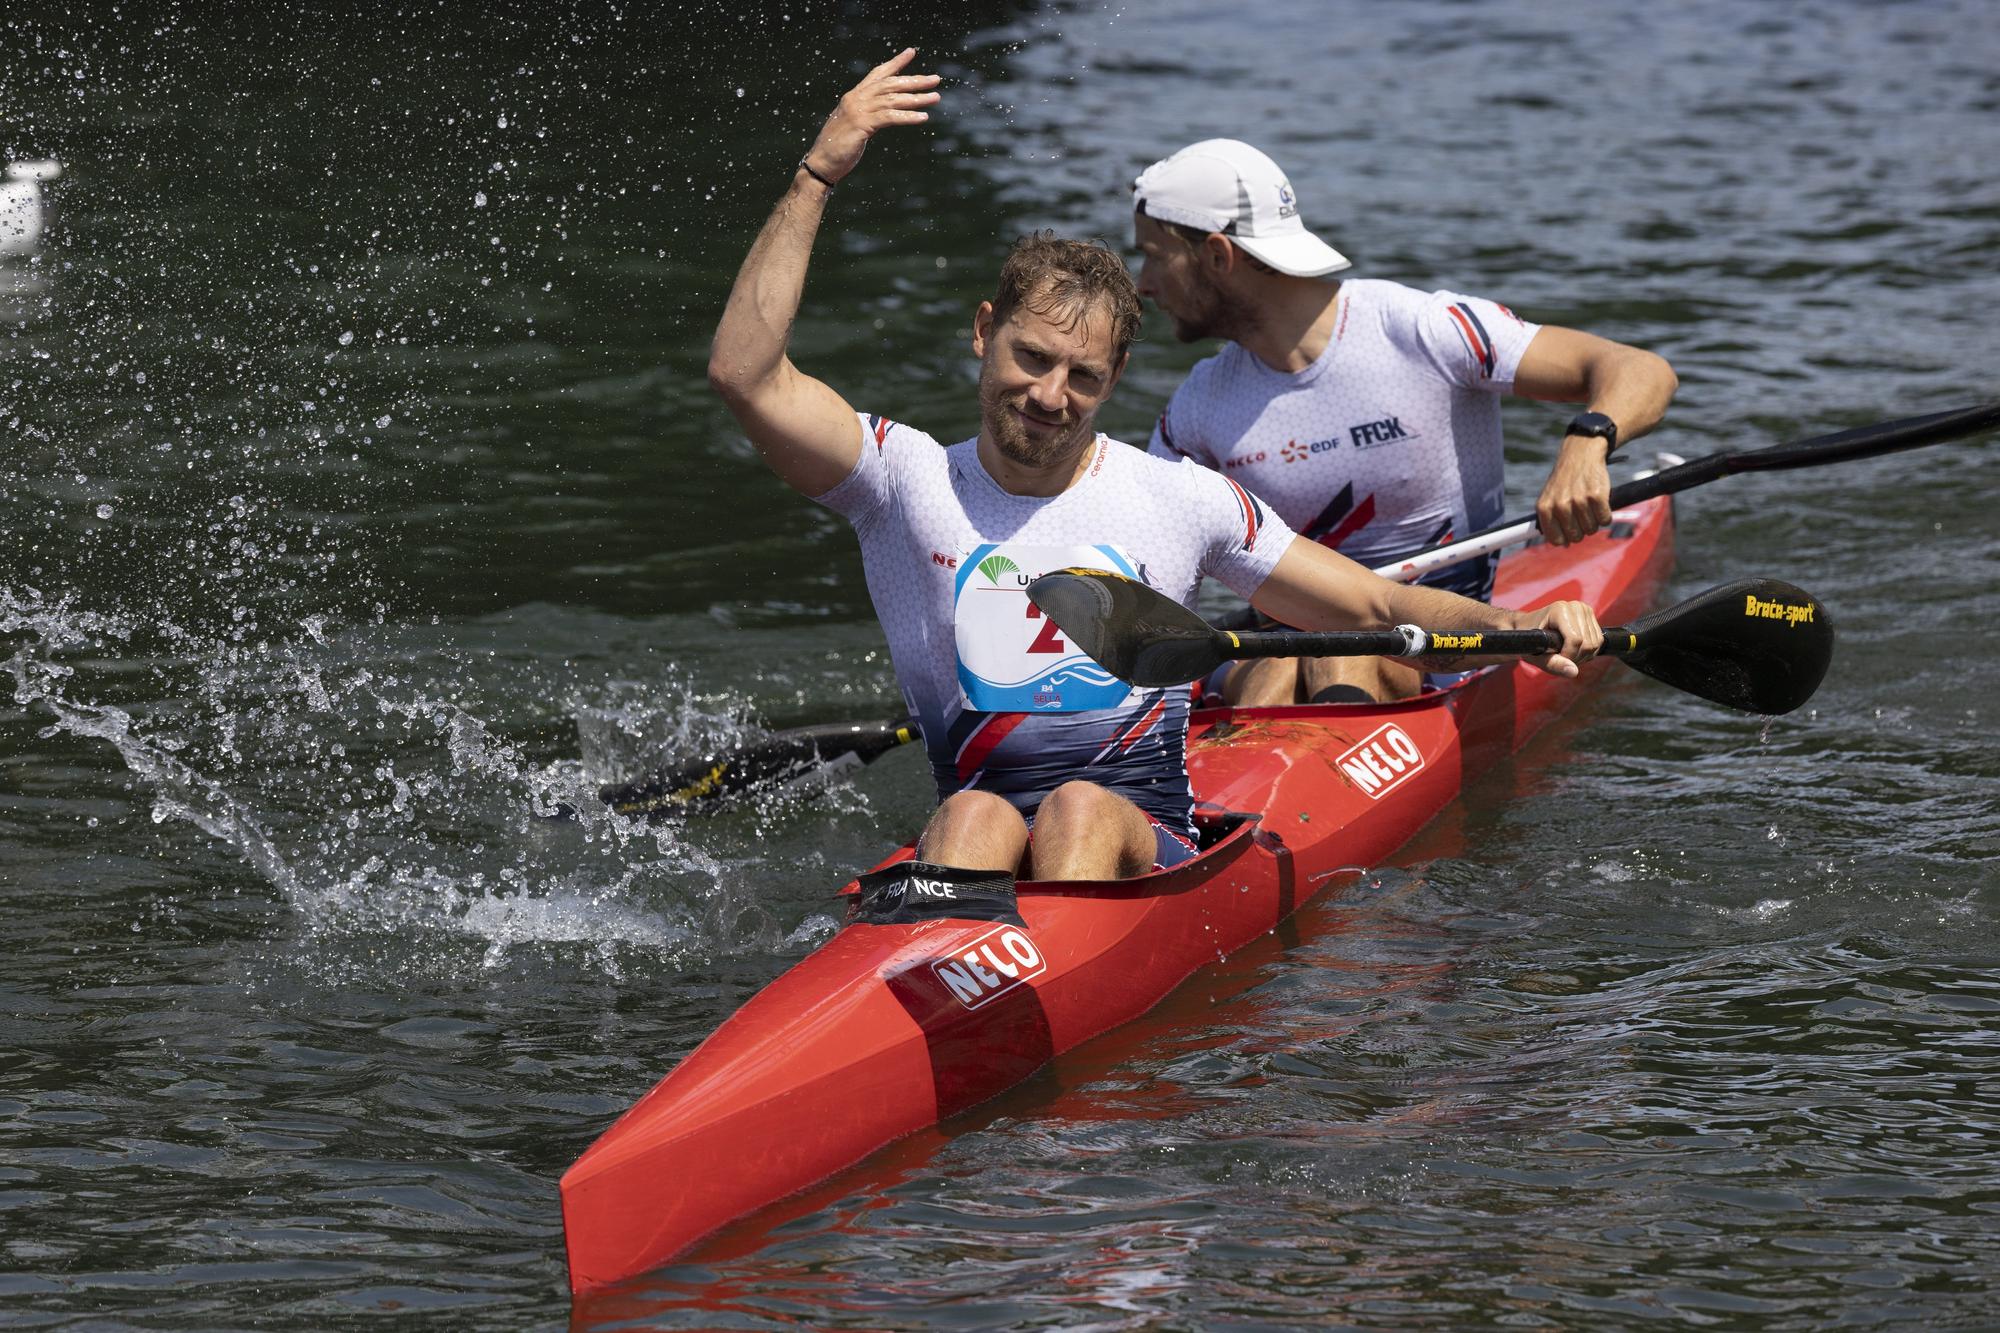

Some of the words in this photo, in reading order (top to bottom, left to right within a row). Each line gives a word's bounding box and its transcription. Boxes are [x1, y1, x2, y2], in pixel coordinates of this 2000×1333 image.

[1350, 416, 1408, 447] FFCK
[932, 553, 957, 567] NE
[1025, 600, 1065, 654] 2
[1033, 695, 1062, 704] SELLA
[1341, 728, 1420, 794] NELO
[938, 930, 1041, 1004] NELO
